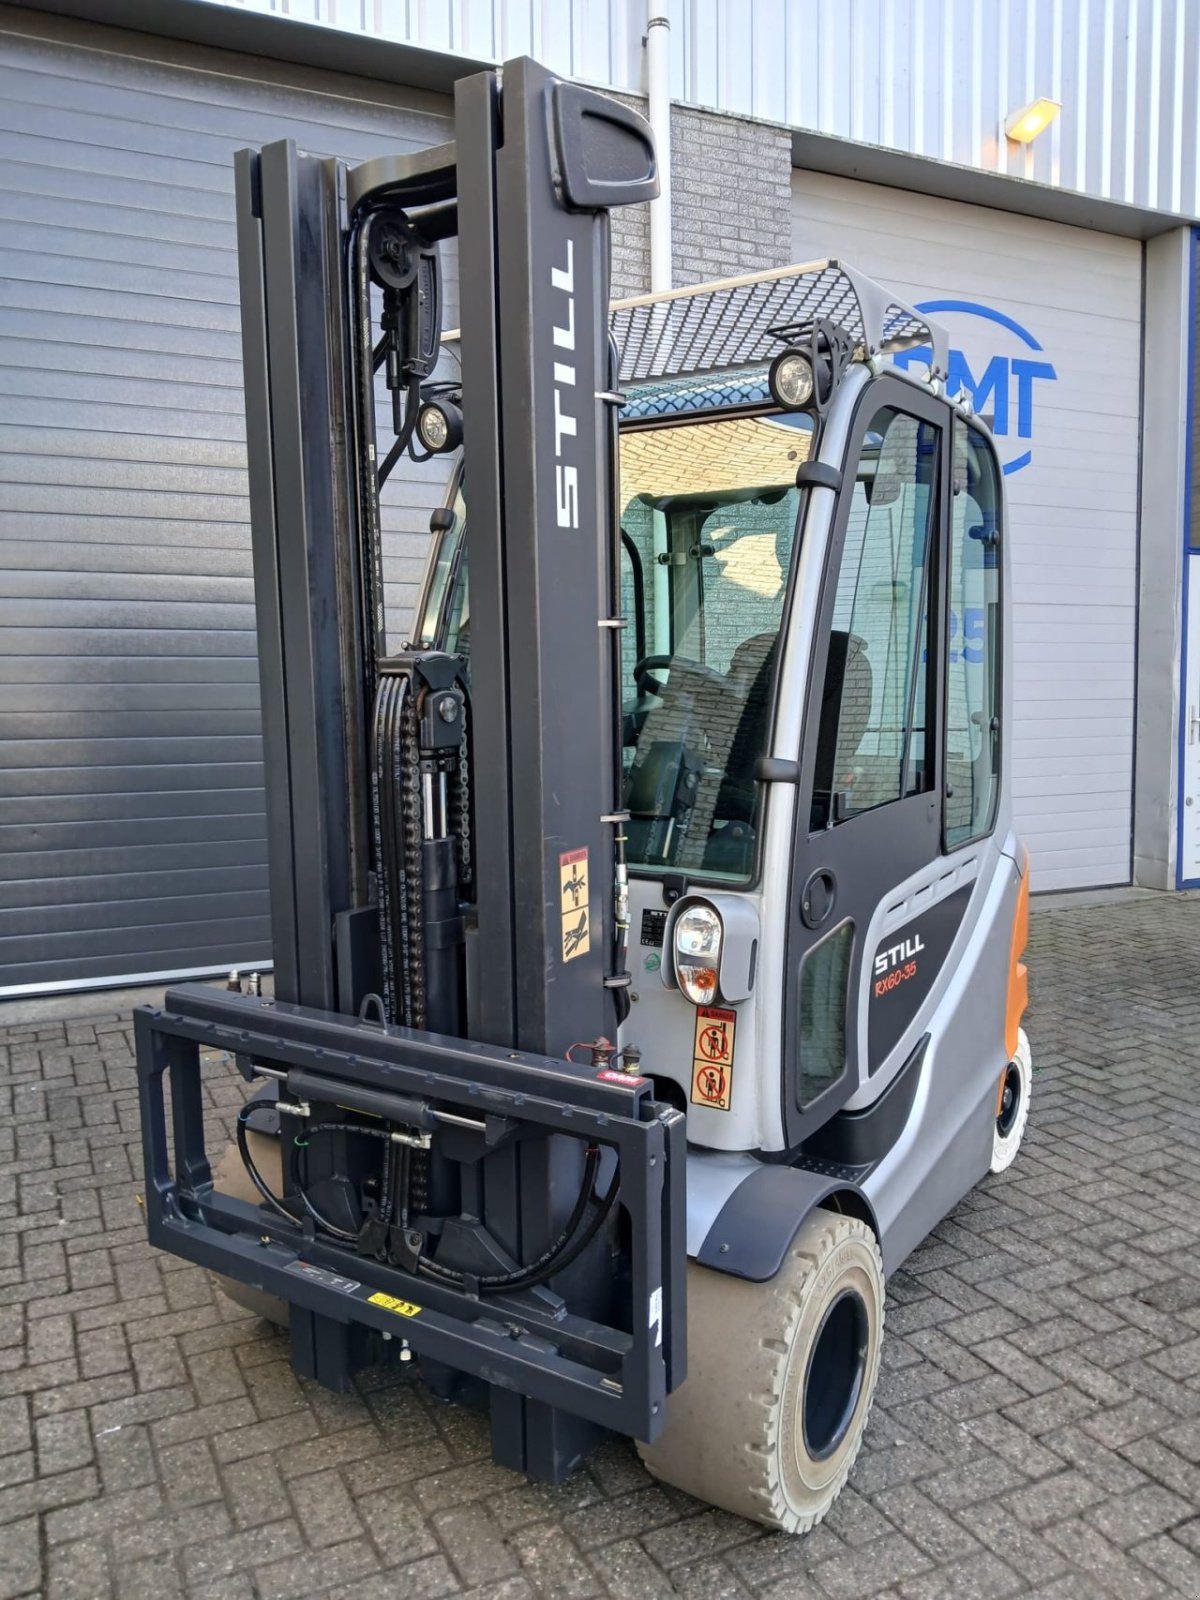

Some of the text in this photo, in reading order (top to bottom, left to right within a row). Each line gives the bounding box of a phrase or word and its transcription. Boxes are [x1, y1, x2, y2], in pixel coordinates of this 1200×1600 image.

[551, 239, 579, 529] STILL
[875, 934, 925, 976] STILL
[875, 960, 917, 998] RX60-35
